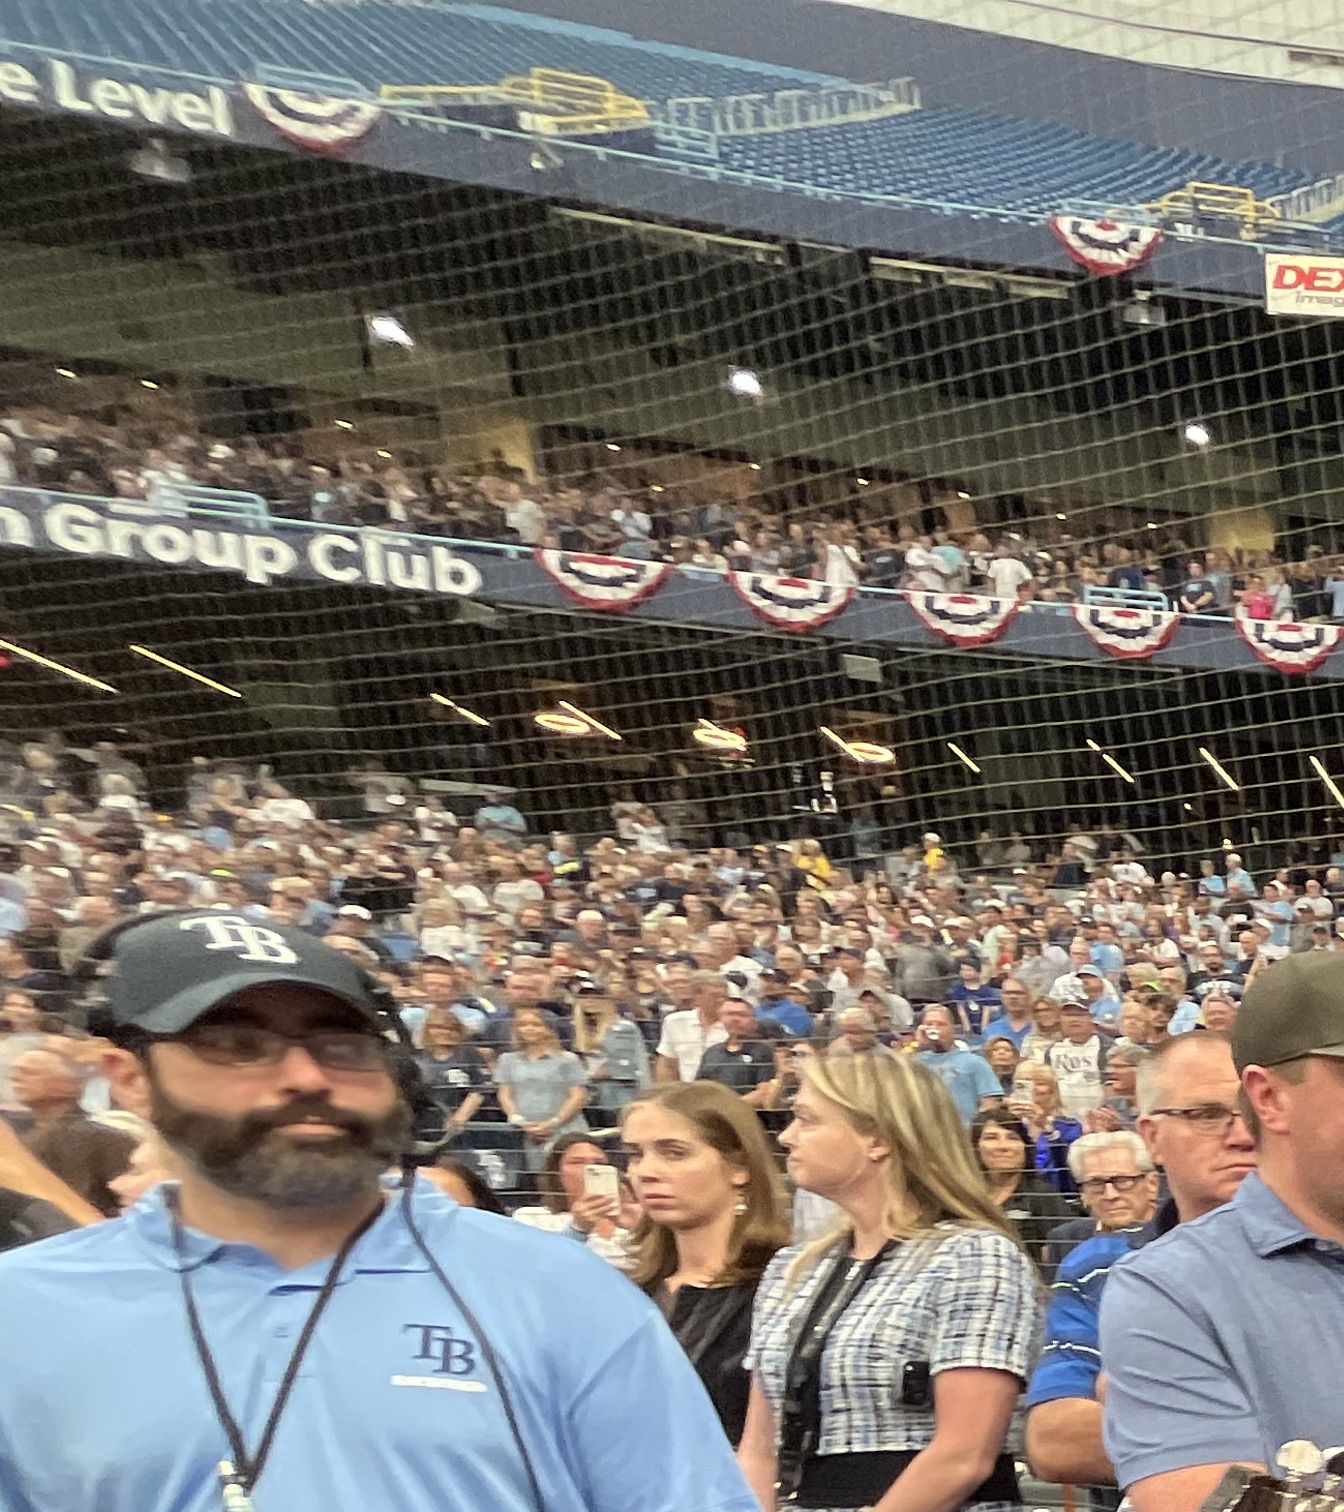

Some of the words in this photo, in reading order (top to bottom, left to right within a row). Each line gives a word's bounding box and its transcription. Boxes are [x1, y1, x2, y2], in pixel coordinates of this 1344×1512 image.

[47, 58, 237, 138] Level
[43, 502, 298, 585] Group
[308, 527, 483, 596] Club
[179, 915, 299, 964] TB
[402, 1323, 476, 1376] TB
